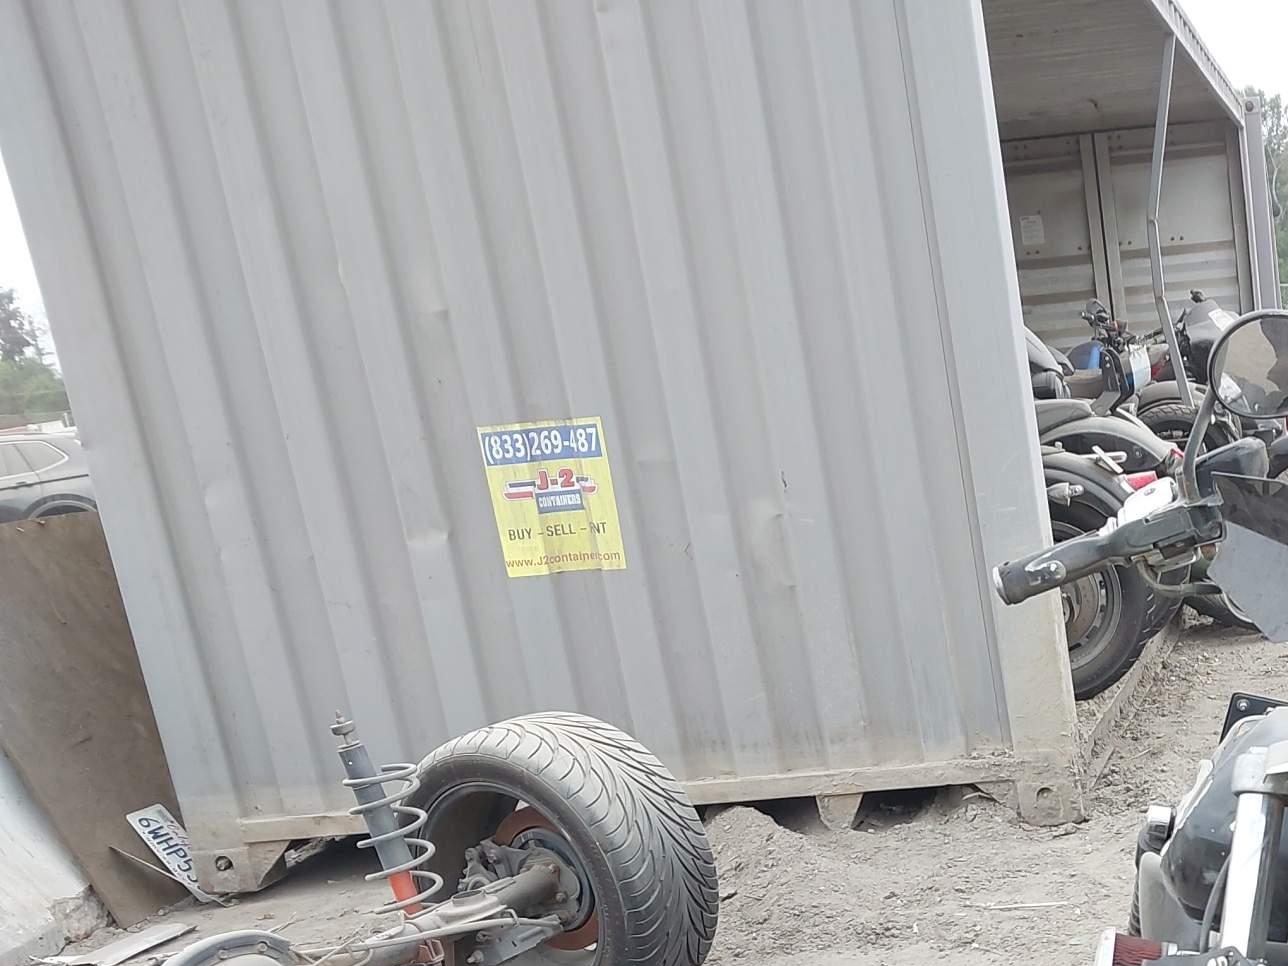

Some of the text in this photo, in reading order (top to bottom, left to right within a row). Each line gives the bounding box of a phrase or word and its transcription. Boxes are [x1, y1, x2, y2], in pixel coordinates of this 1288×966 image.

[537, 468, 575, 490] J-2
[538, 494, 582, 508] CONTAINERS
[508, 528, 532, 541] BUY
[546, 523, 576, 537] SELL
[138, 817, 201, 890] 6WHP5
